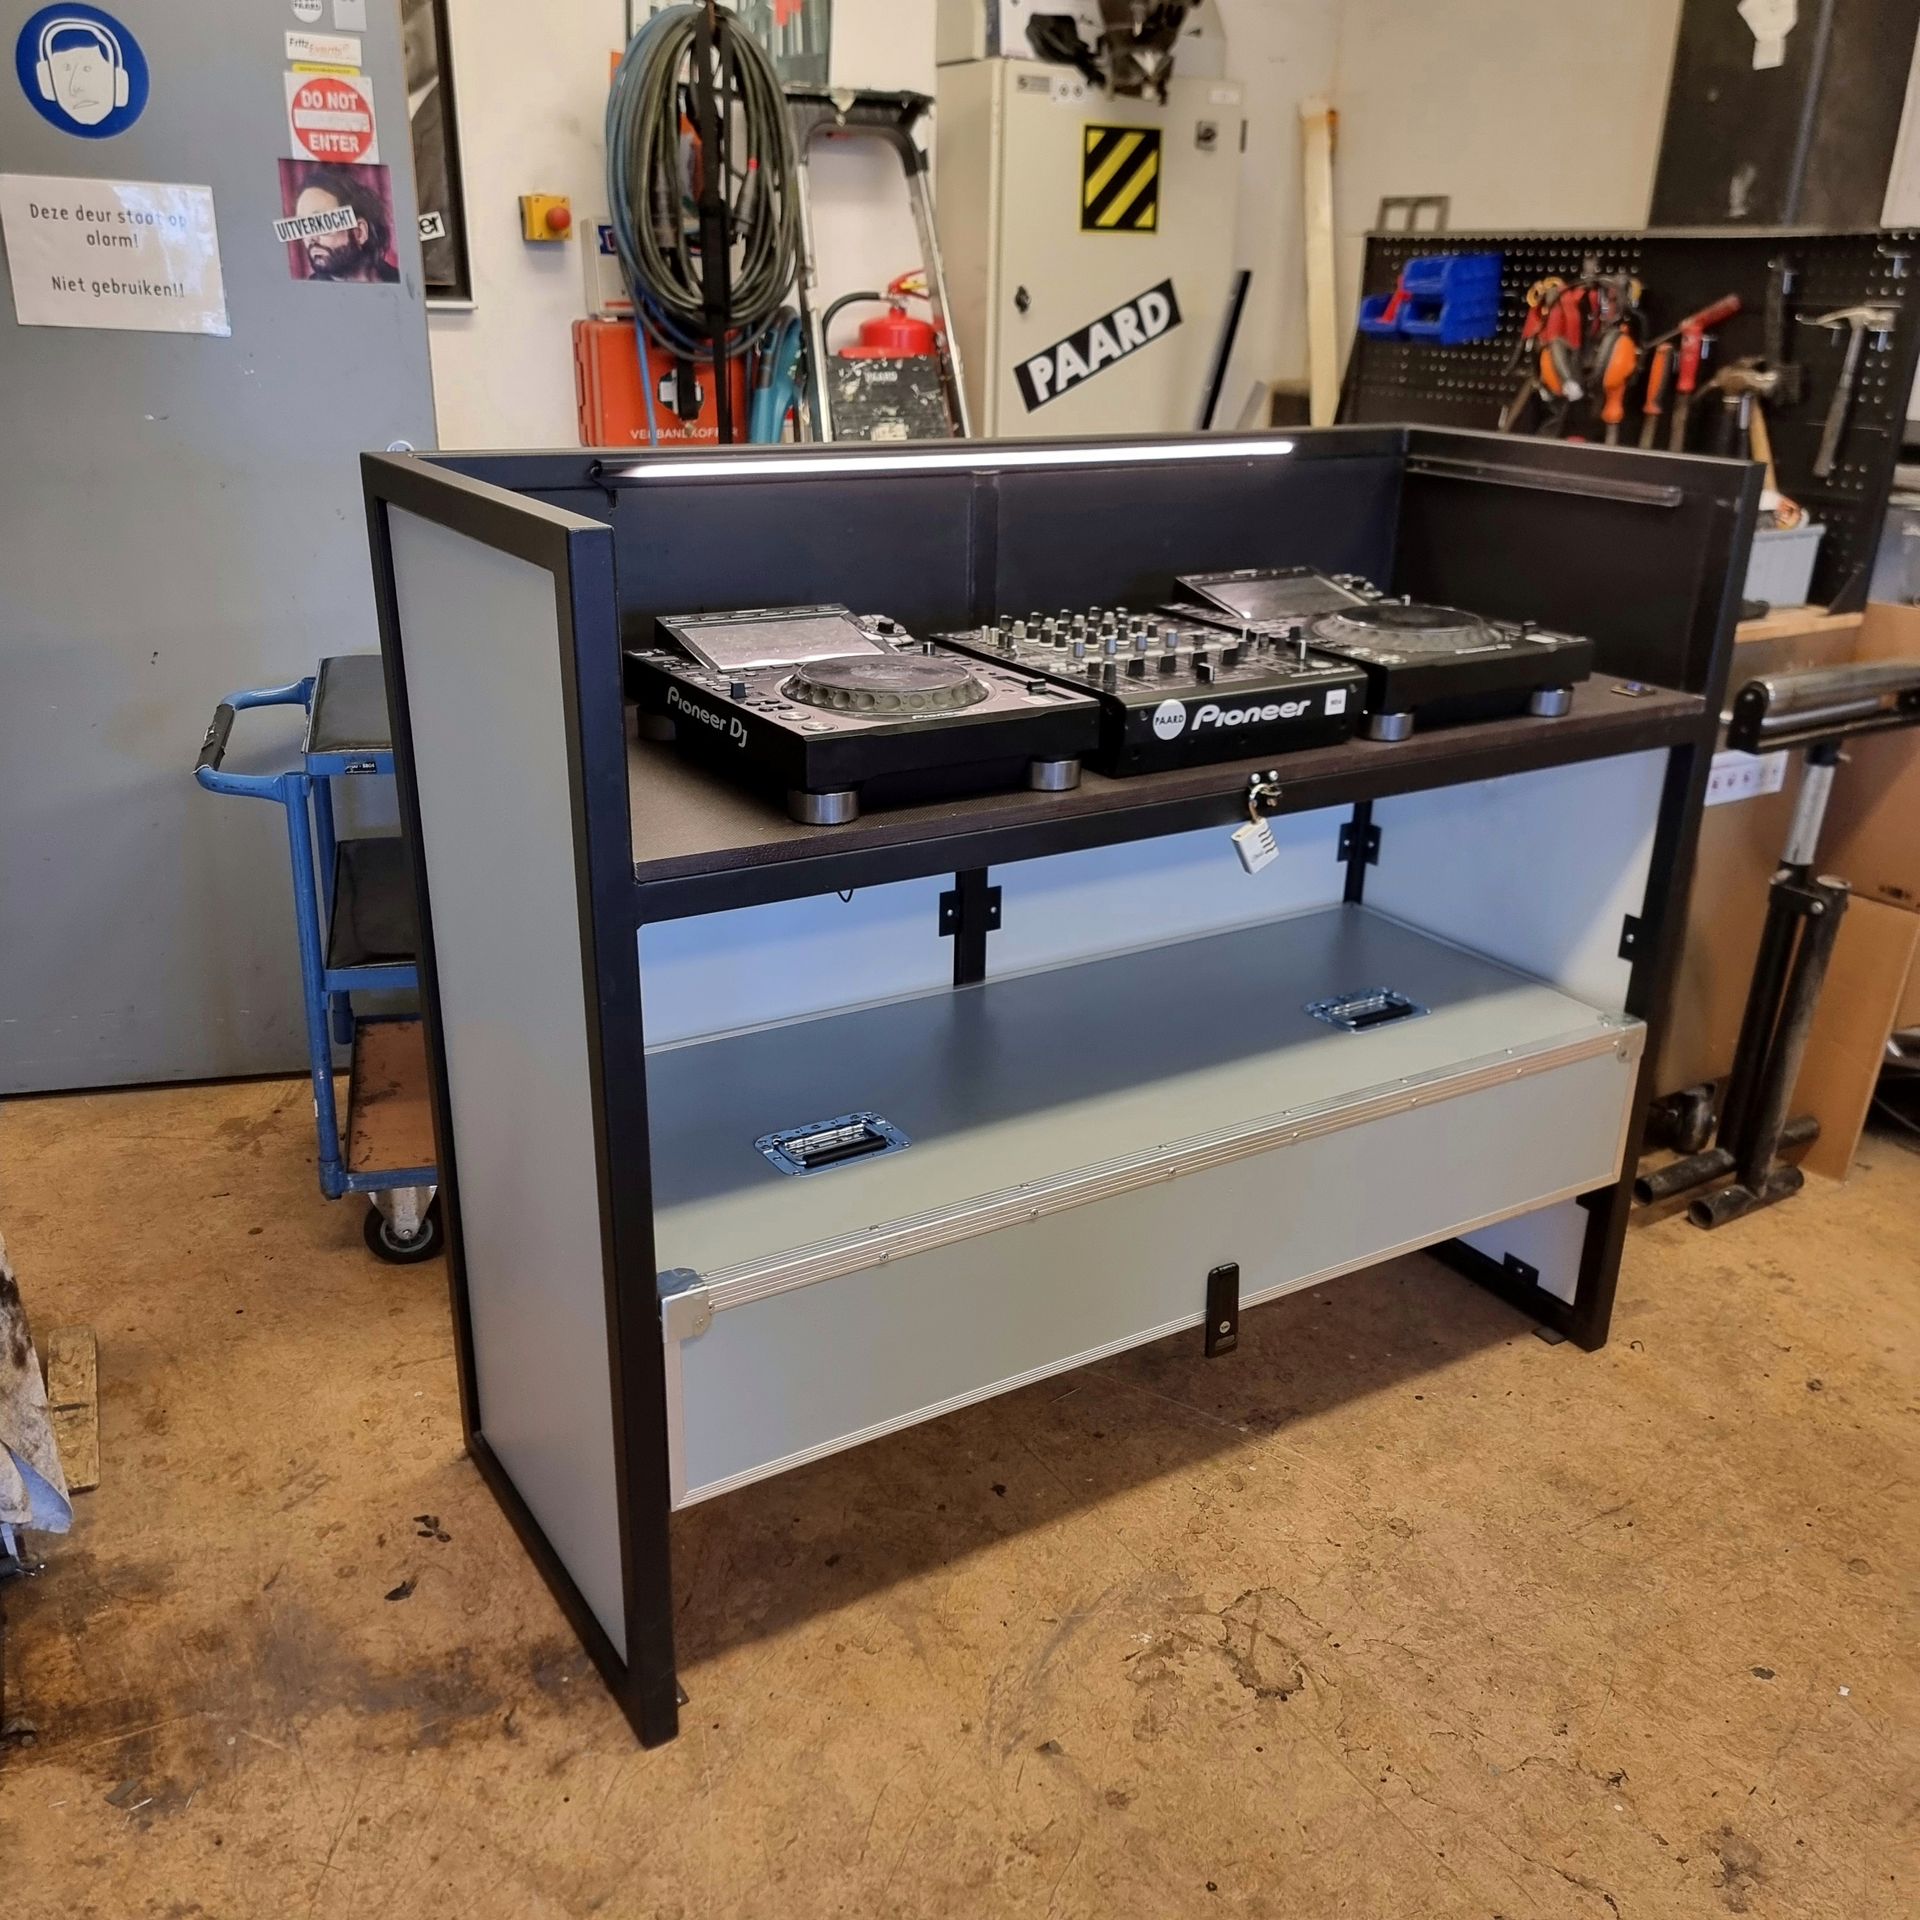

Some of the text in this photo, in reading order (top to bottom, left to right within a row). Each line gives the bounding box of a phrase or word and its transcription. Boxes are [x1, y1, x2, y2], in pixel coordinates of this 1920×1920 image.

[301, 89, 358, 111] DO NOT
[309, 132, 359, 153] ENTER
[30, 203, 69, 220] Deze
[76, 205, 111, 223] deur
[117, 210, 161, 225] staat
[276, 209, 355, 240] UITVERKOCHT
[86, 230, 139, 248] alarm!
[51, 276, 185, 298] Niet gebruiken!!
[1027, 291, 1171, 403] PAARD
[667, 686, 727, 731] Pioneer
[1155, 700, 1312, 731] PAARD Pioneer
